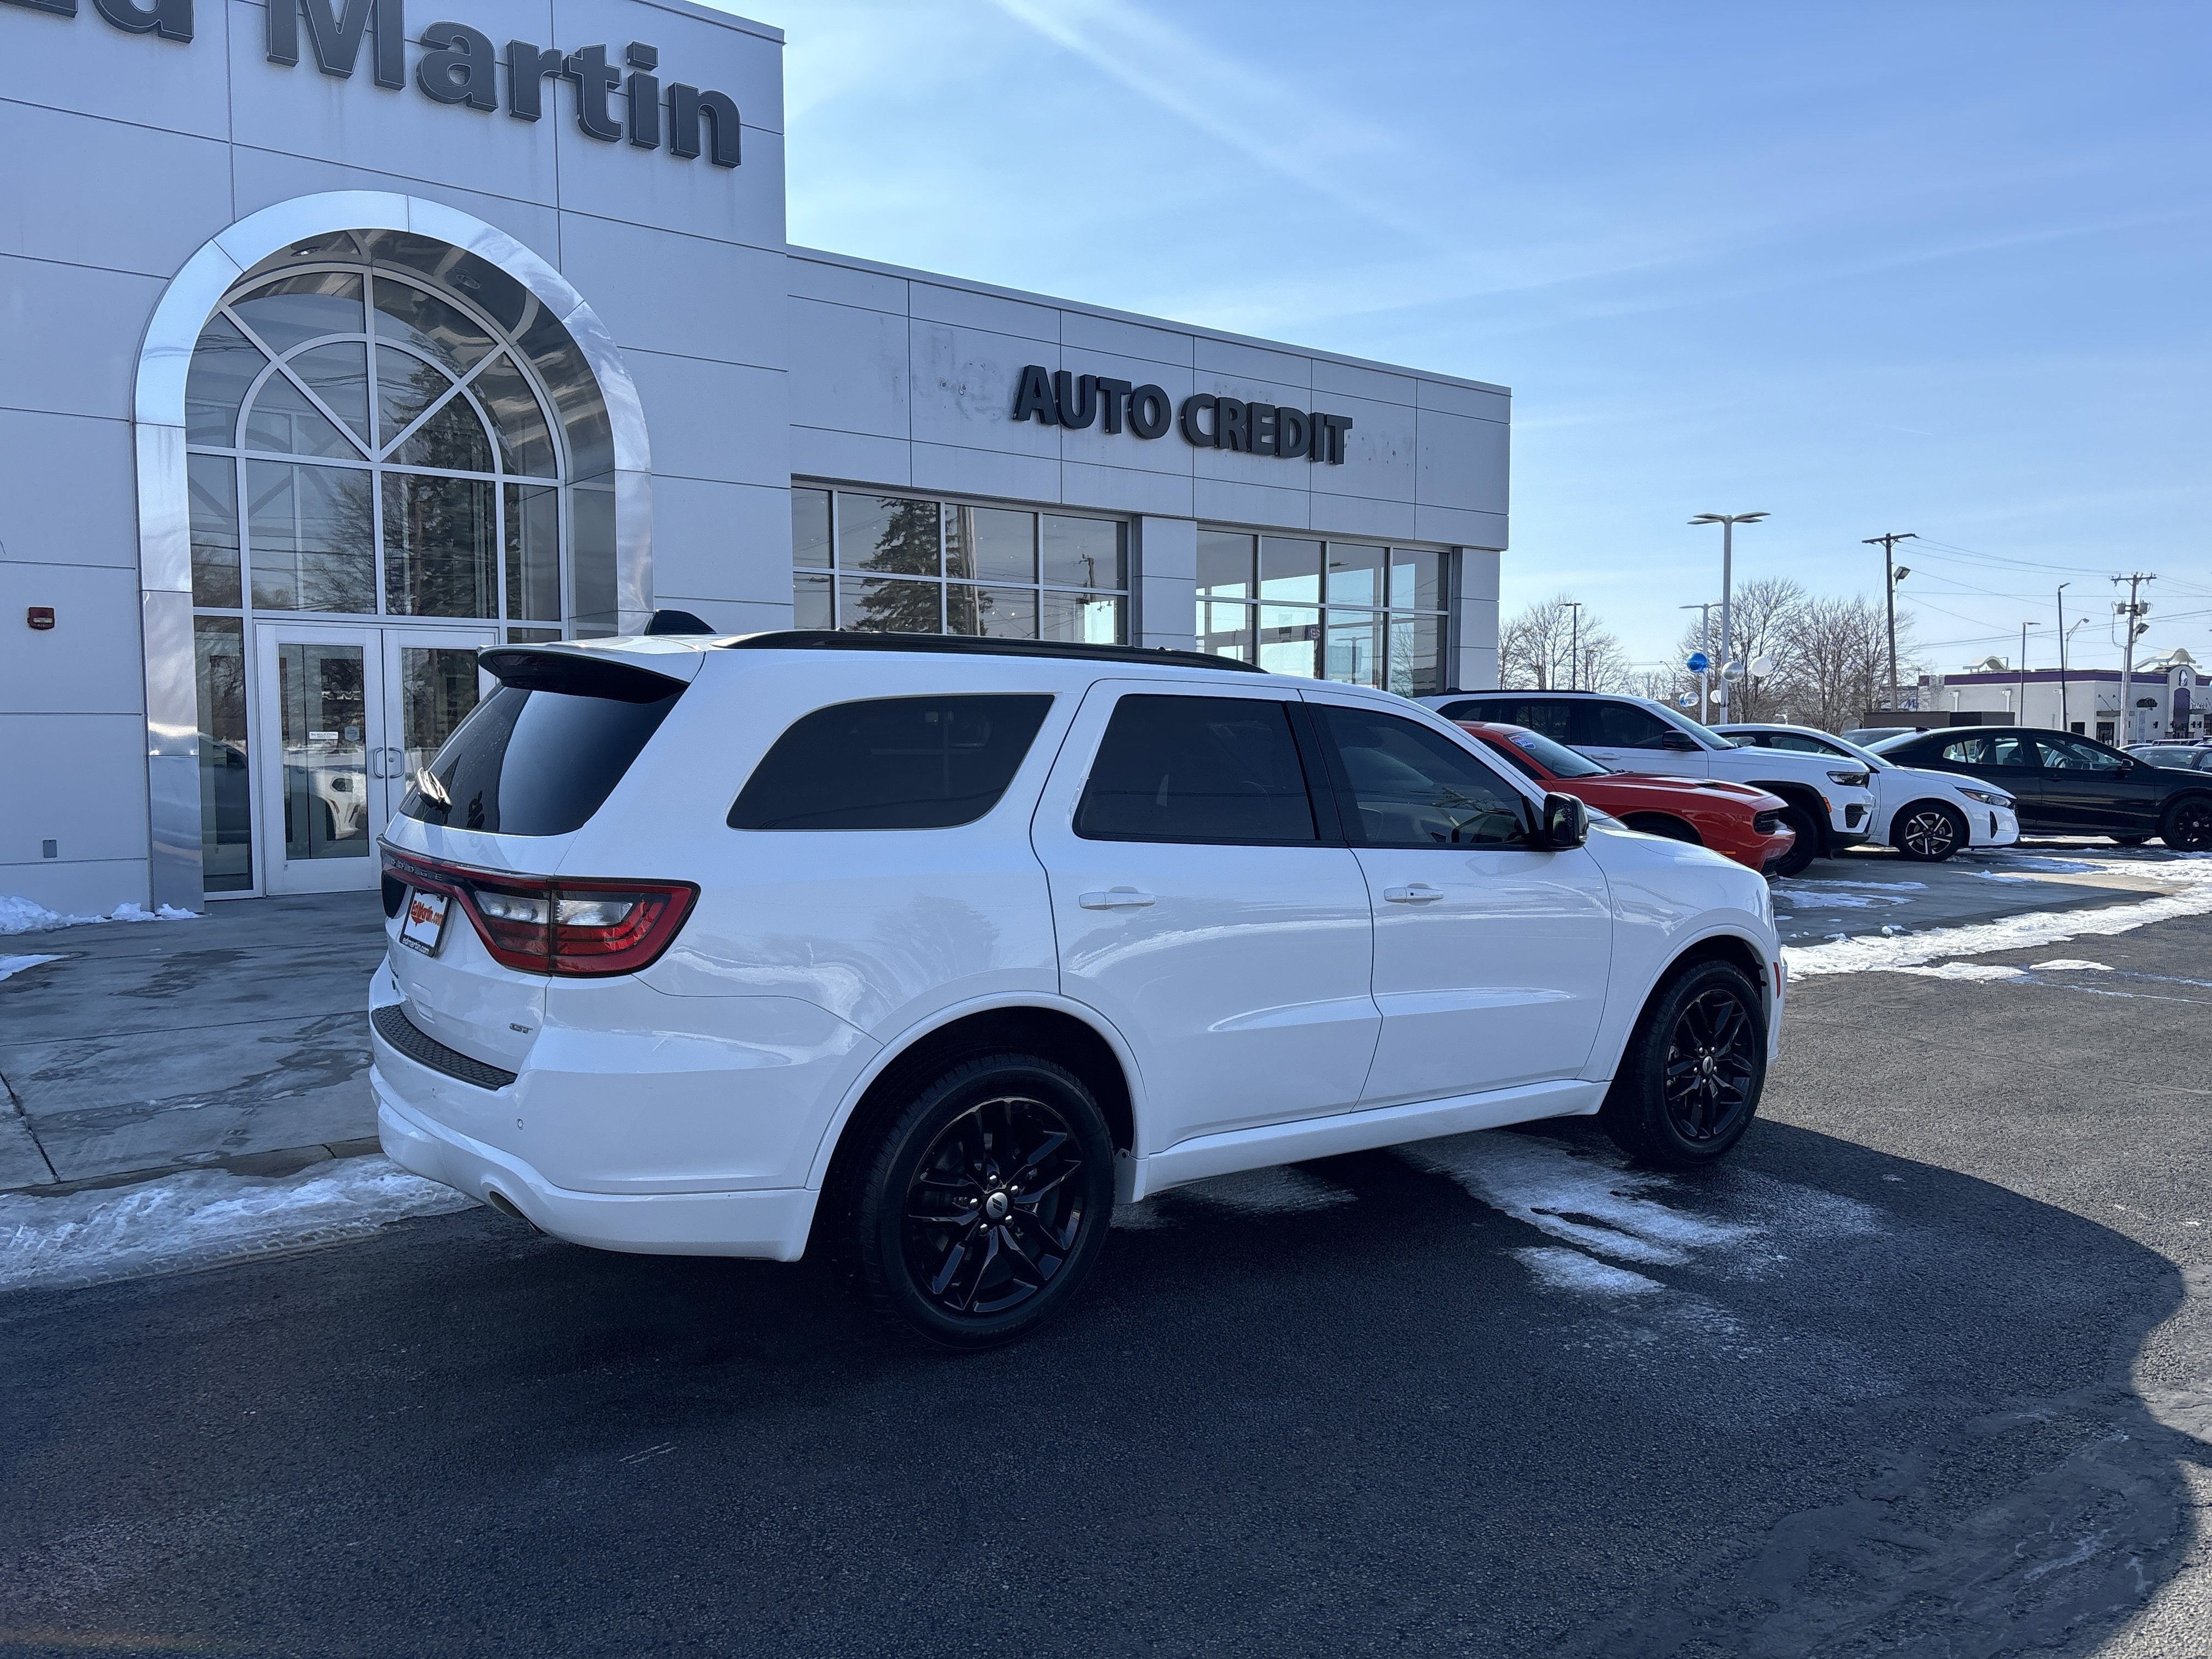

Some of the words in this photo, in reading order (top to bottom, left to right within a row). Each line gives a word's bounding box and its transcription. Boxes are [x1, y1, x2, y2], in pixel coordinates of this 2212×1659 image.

[267, 0, 741, 167] Martin
[1013, 364, 1171, 439] AUTO
[1181, 393, 1352, 465] CREDIT
